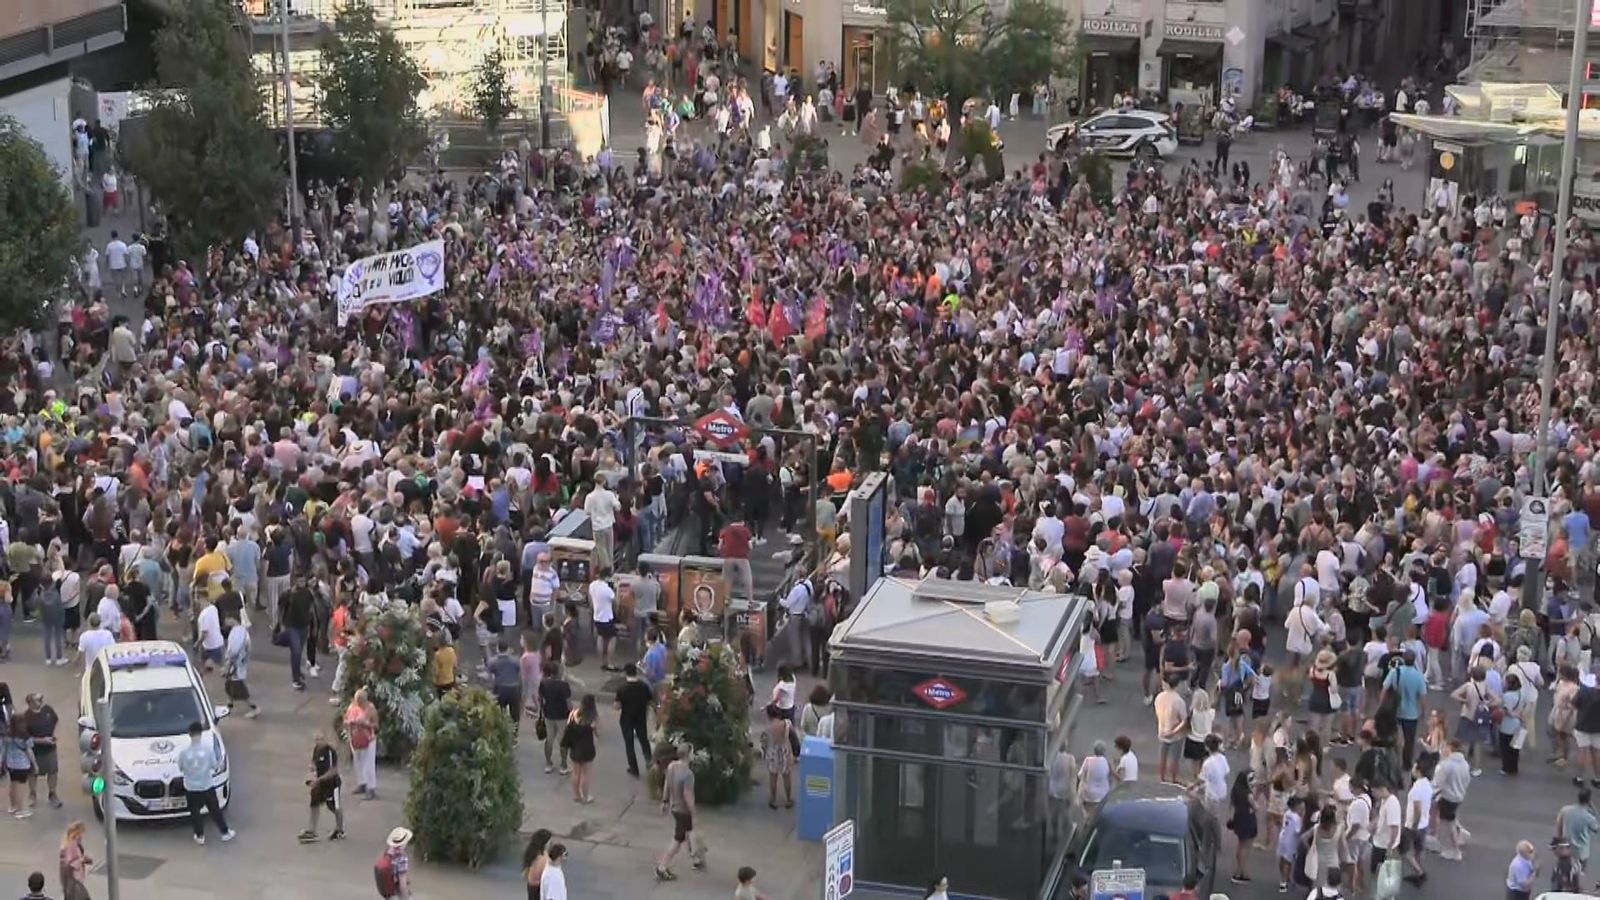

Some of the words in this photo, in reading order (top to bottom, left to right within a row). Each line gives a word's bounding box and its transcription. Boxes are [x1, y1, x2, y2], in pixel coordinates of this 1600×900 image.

[1083, 19, 1138, 33] RODILLA
[1165, 25, 1222, 38] RODILLA
[707, 423, 733, 434] Metro
[928, 688, 951, 698] Metro
